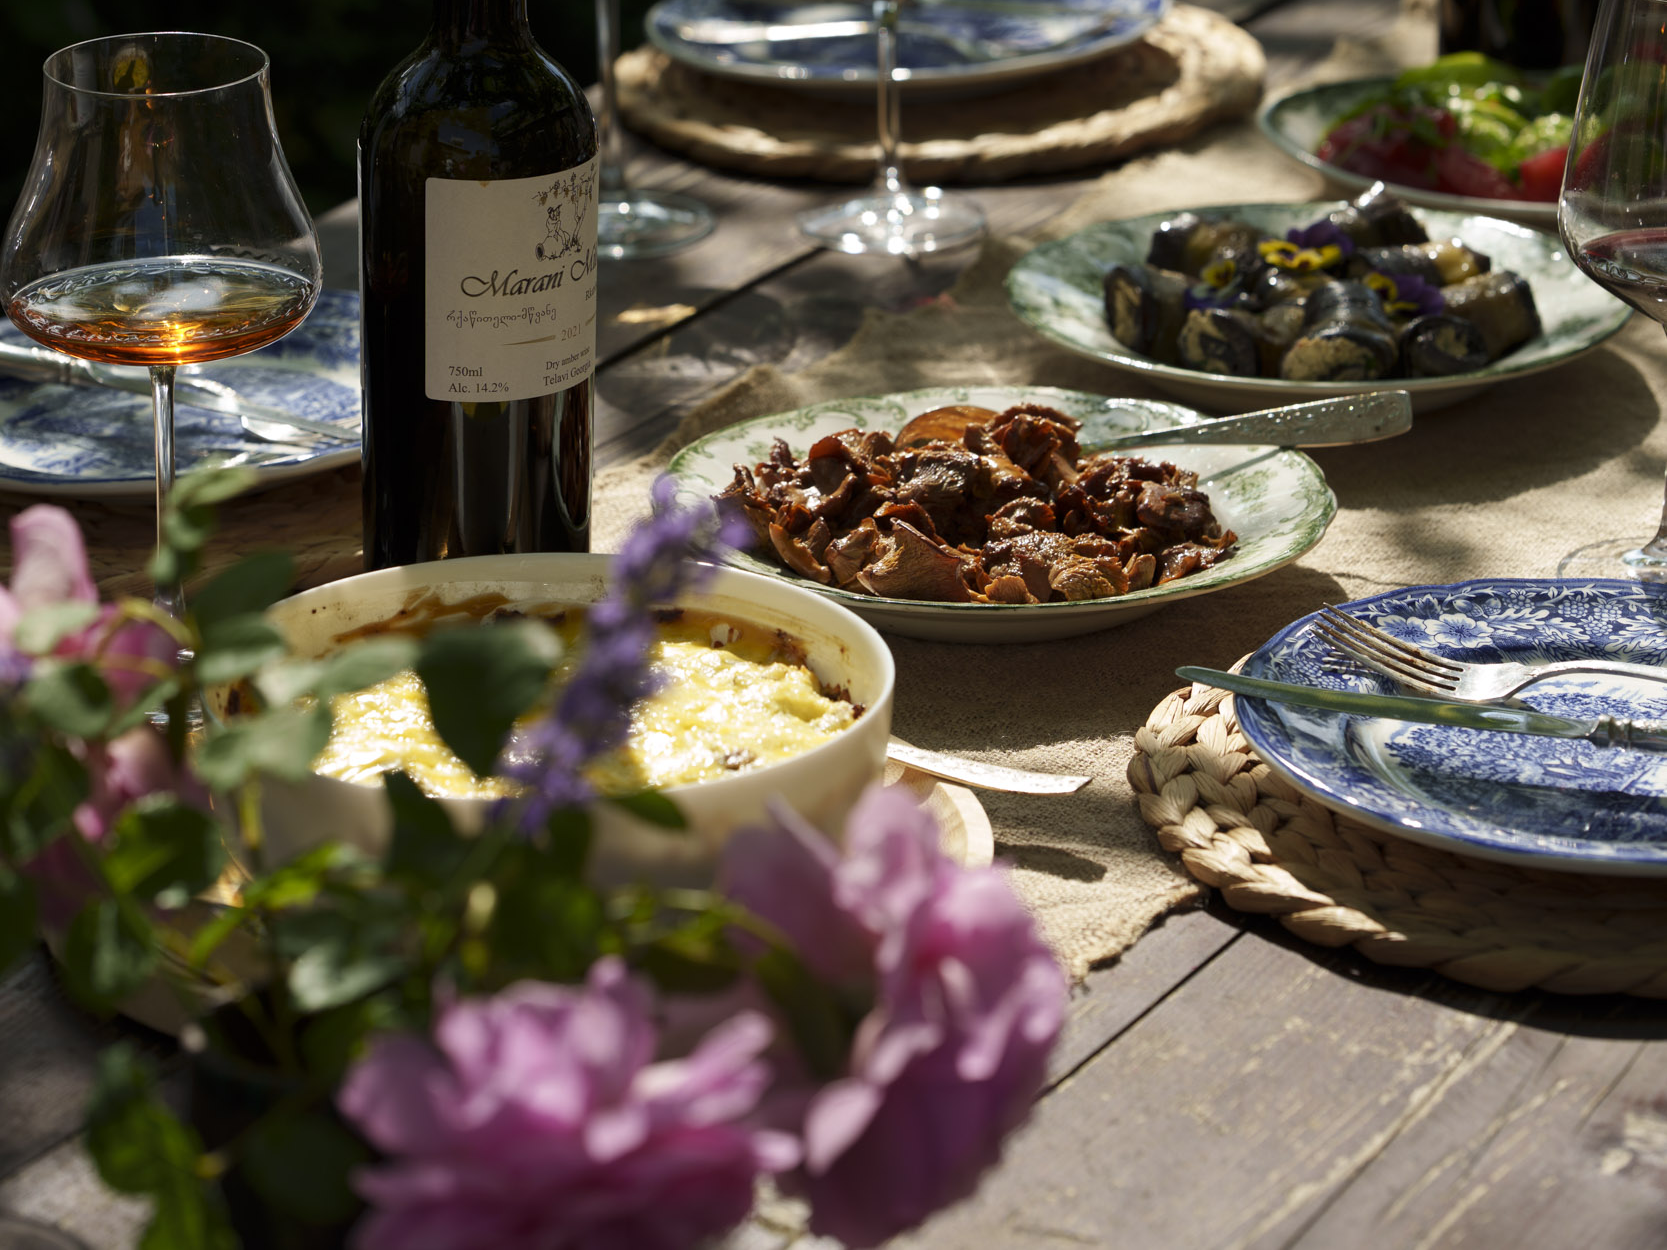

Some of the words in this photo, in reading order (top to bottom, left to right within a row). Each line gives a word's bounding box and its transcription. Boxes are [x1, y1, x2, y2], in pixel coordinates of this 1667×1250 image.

[460, 265, 565, 297] Marani
[446, 303, 557, 329] რქაწითელი-მწვანე
[561, 322, 581, 341] 2021
[448, 365, 483, 377] 750ml
[545, 361, 560, 371] Dry
[561, 352, 580, 366] amber
[448, 382, 471, 394] Alc.
[476, 381, 510, 393] 14.2%
[543, 370, 569, 387] Telavi
